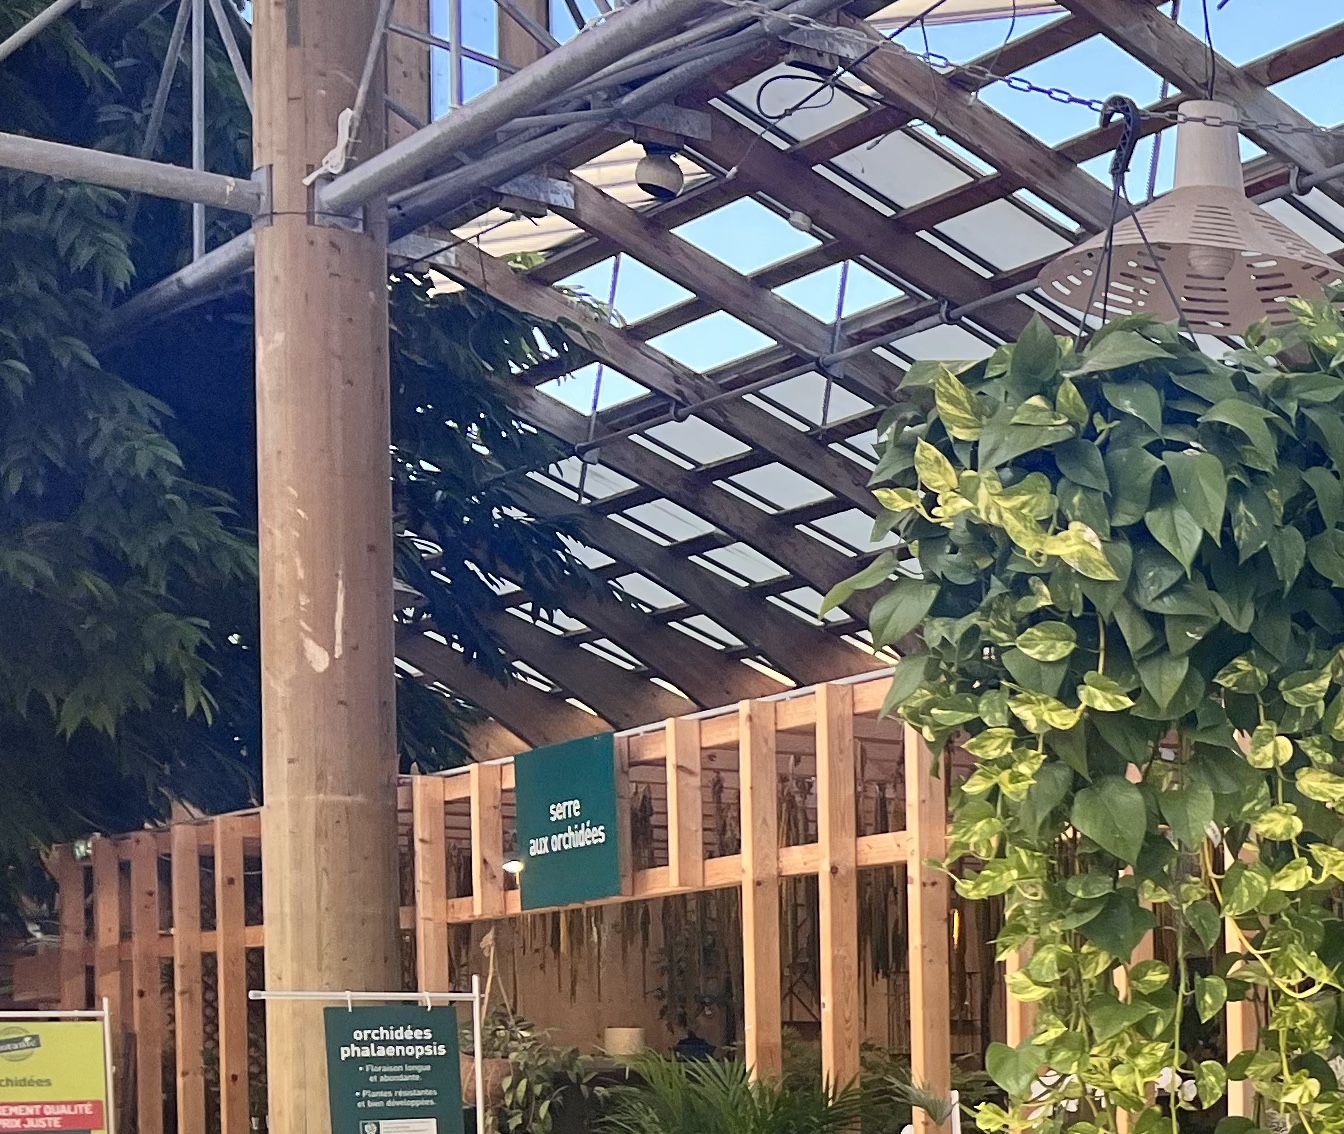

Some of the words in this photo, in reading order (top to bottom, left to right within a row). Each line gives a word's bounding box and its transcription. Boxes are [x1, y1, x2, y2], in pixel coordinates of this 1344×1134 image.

[549, 799, 581, 822] serre
[529, 836, 550, 857] aux
[550, 820, 606, 852] orchidées
[353, 1025, 433, 1041] orchidées
[340, 1042, 447, 1061] phalaenopsis
[0, 1075, 52, 1087] chidées
[0, 1105, 41, 1116] EMENT
[43, 1102, 93, 1115] QUALITÉ
[23, 1117, 62, 1128] JUSTE
